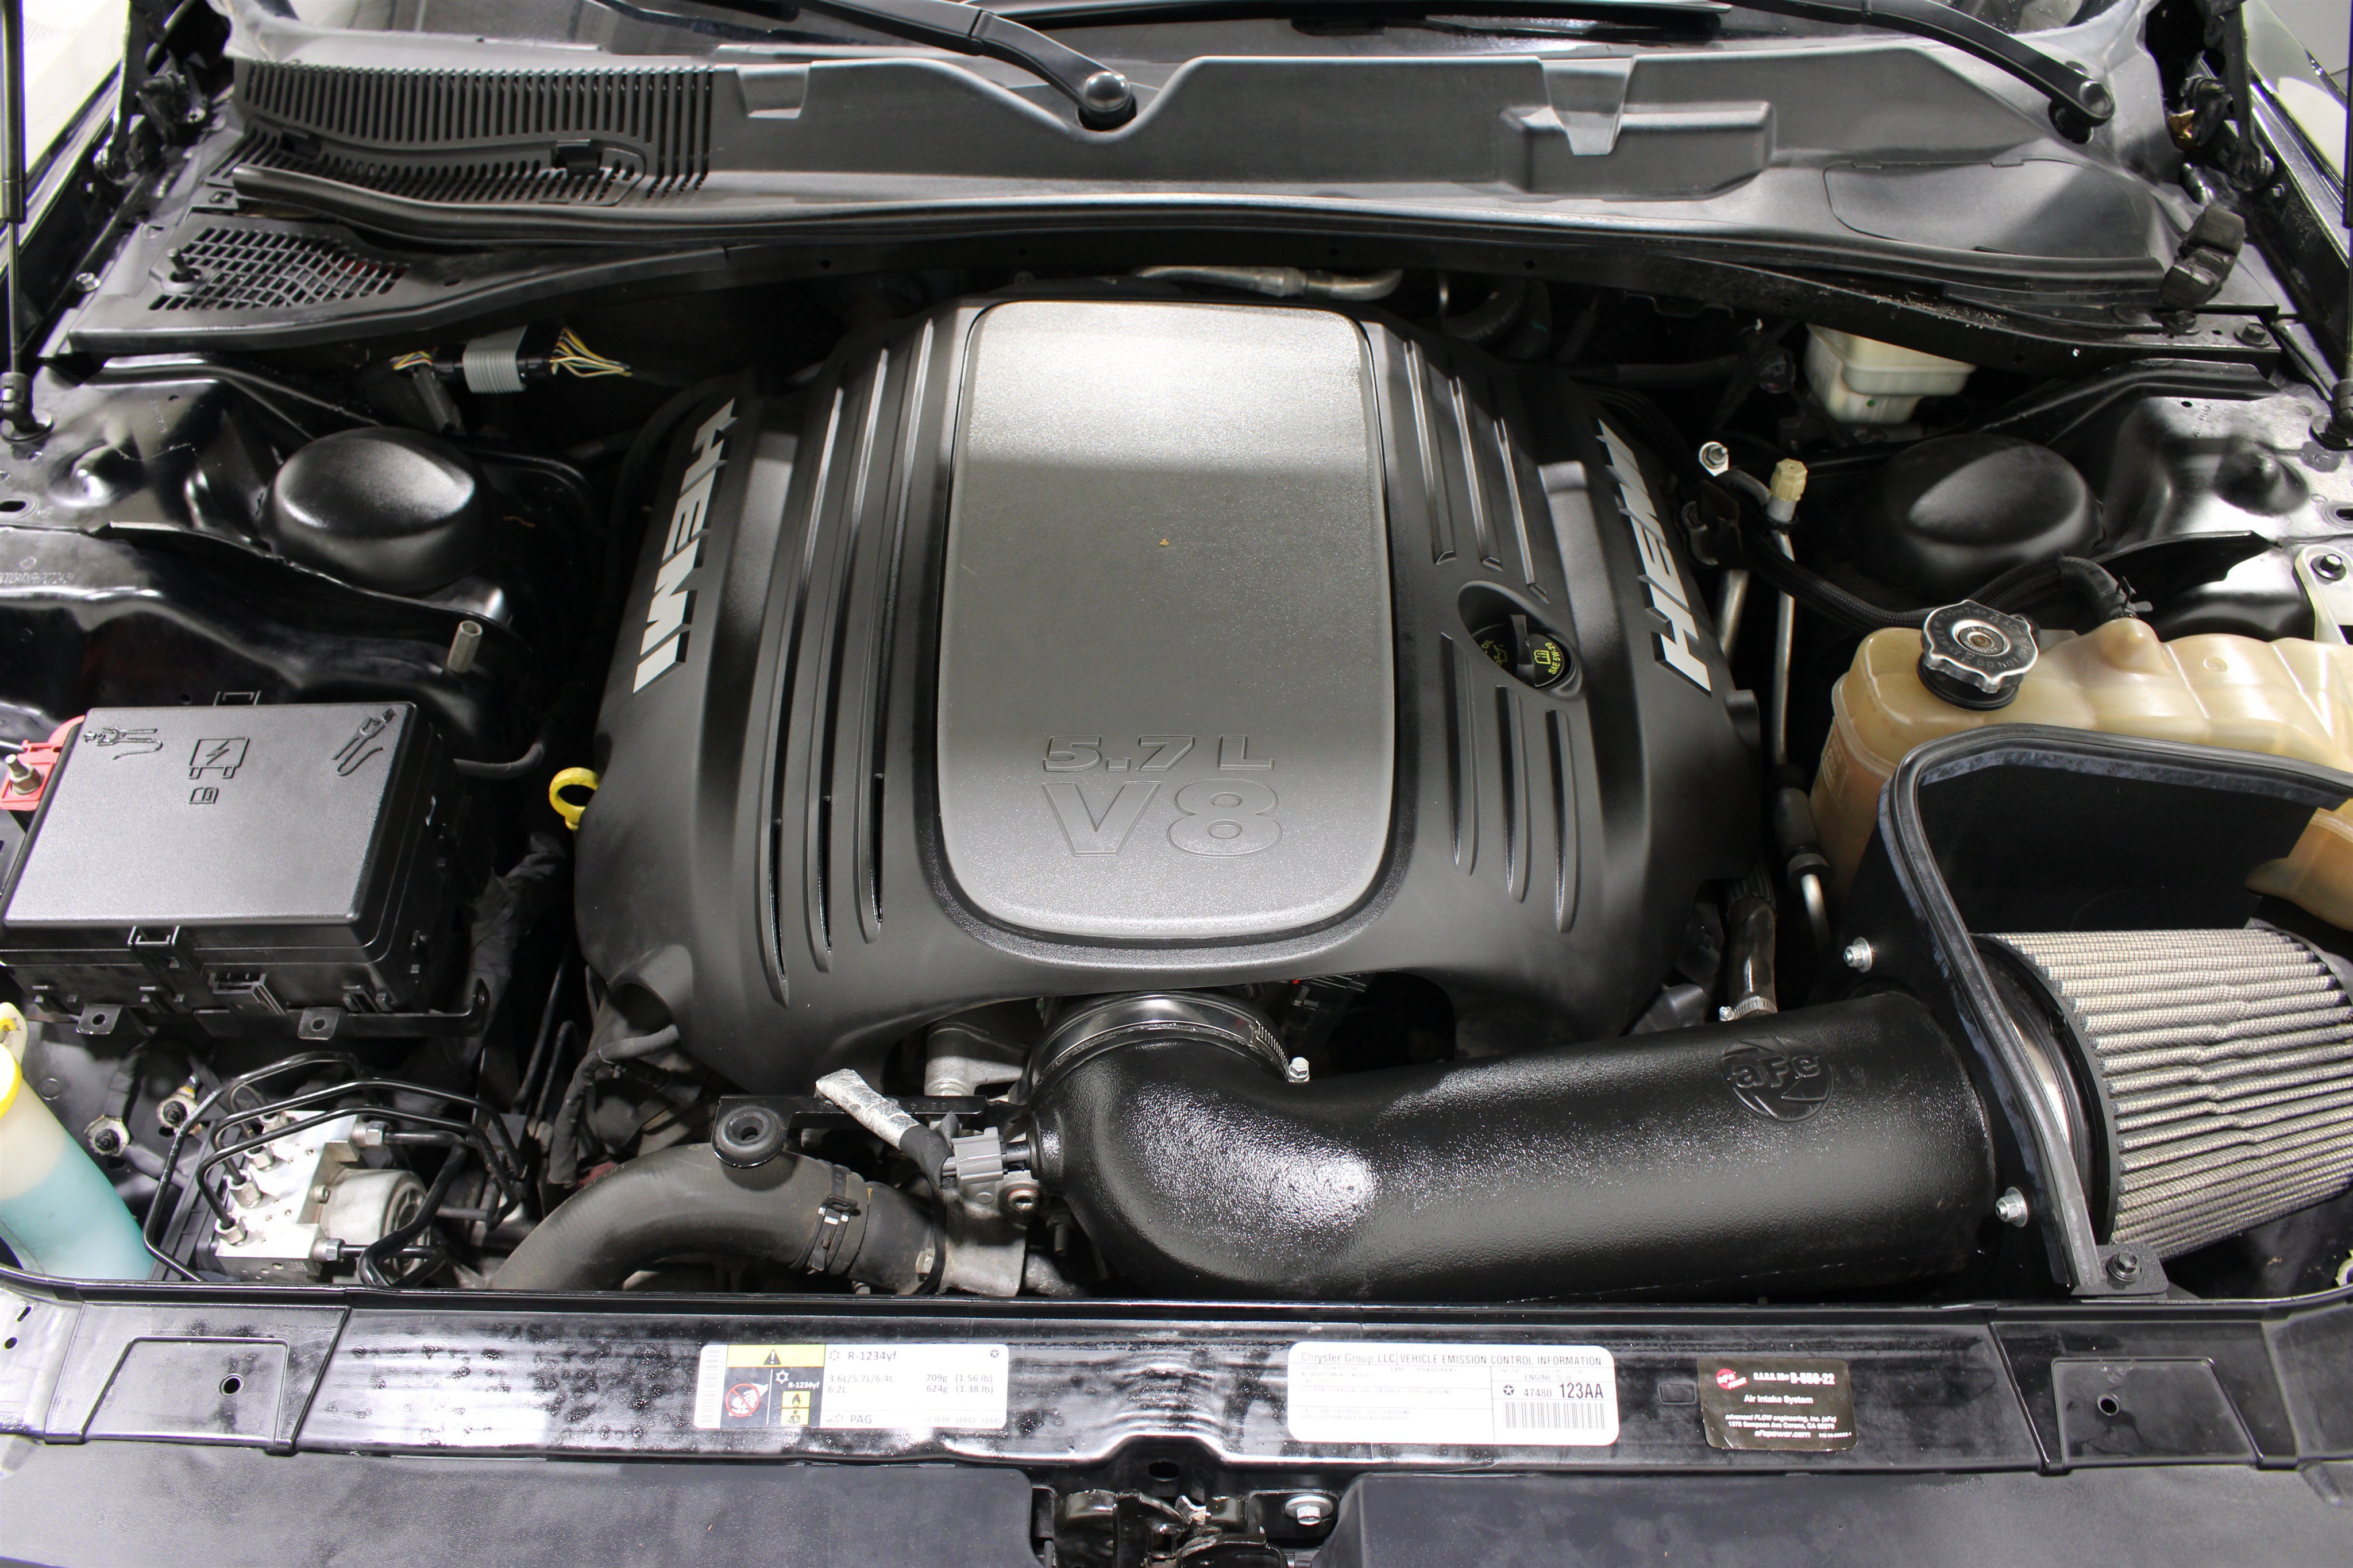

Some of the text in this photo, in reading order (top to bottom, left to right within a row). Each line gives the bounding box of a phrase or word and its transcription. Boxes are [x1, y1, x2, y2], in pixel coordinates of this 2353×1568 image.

[633, 398, 738, 693] HEMI
[1596, 419, 1711, 696] HEMI
[1545, 642, 1561, 674] SAE 5W-20
[1042, 778, 1282, 858] V8
[848, 1351, 897, 1362] R-1234yf
[1301, 1352, 1395, 1365] Chrysler Group LLC
[1400, 1354, 1601, 1366] VEHICLE EMISSION CONTROL INFORMATION
[927, 1374, 947, 1383] 709g
[955, 1374, 978, 1383] (1.56
[981, 1374, 993, 1383] lb)
[788, 1381, 820, 1389] R-1234yf
[927, 1385, 948, 1393] 624g
[956, 1385, 978, 1394] (1.38
[982, 1385, 993, 1394] lb)
[1523, 1382, 1604, 1399] 47480 123AA
[1744, 1394, 1814, 1404] Air Intake System
[850, 1415, 872, 1424] PAG
